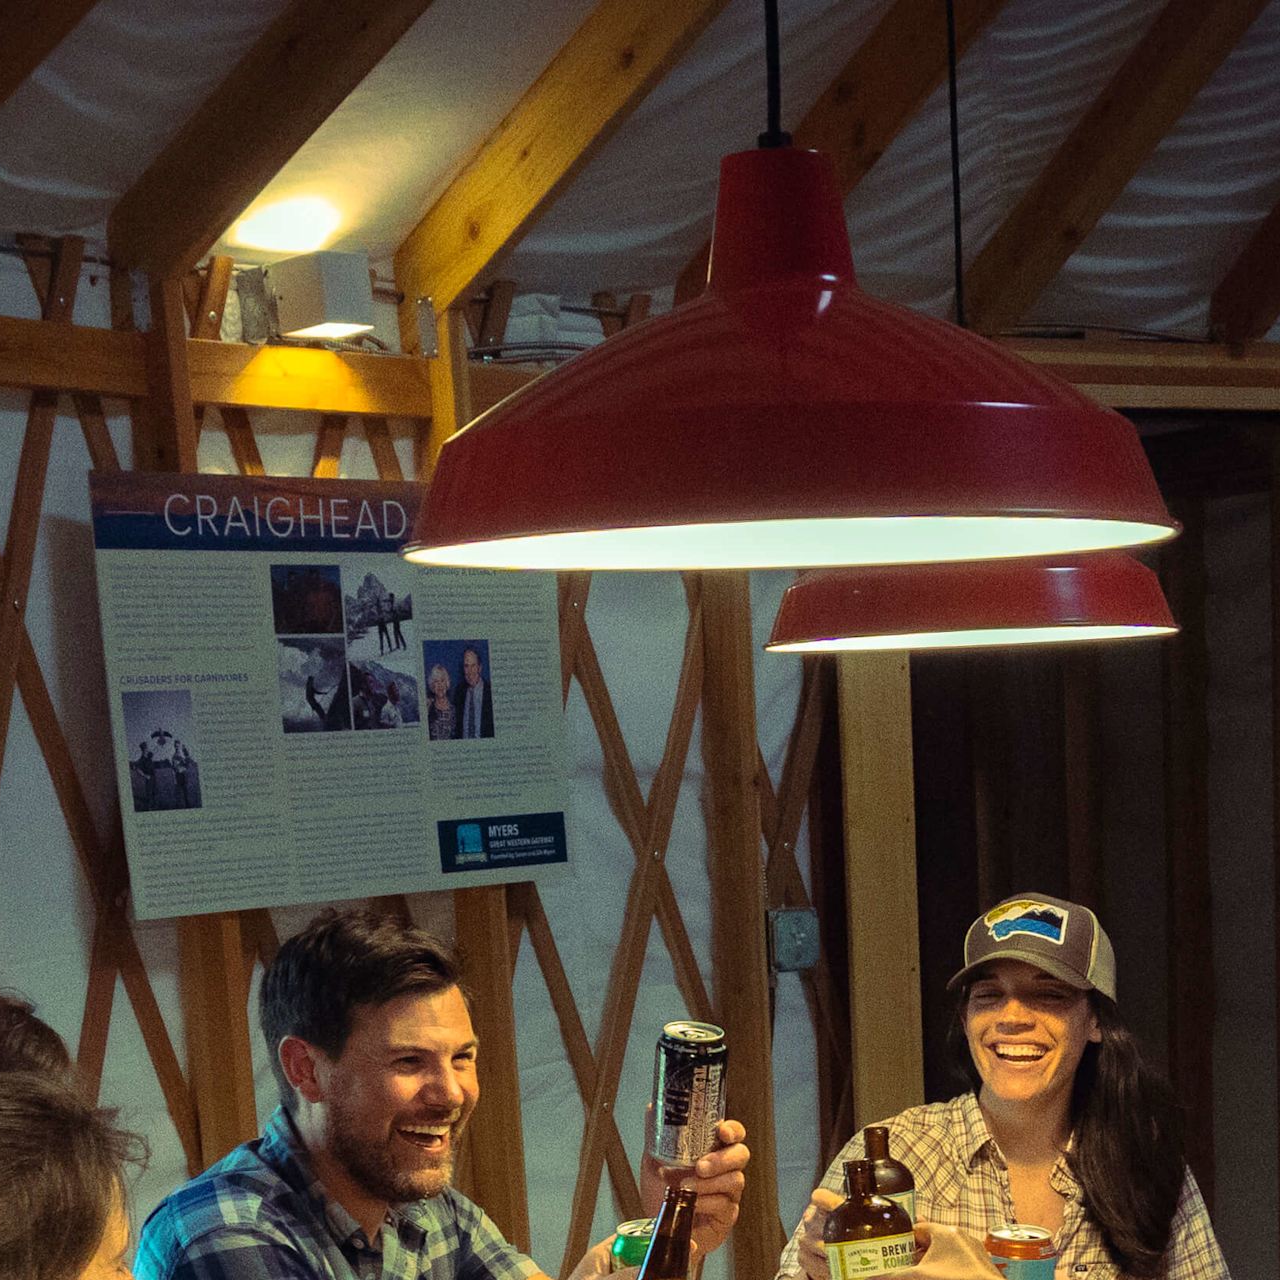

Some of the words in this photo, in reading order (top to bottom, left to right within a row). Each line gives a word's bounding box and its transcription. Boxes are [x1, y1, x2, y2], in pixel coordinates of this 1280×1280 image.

[163, 493, 408, 540] CRAIGHEAD
[174, 674, 193, 684] FOR
[488, 824, 519, 837] MYERS
[664, 1089, 689, 1126] IPA
[881, 1243, 907, 1257] BREW
